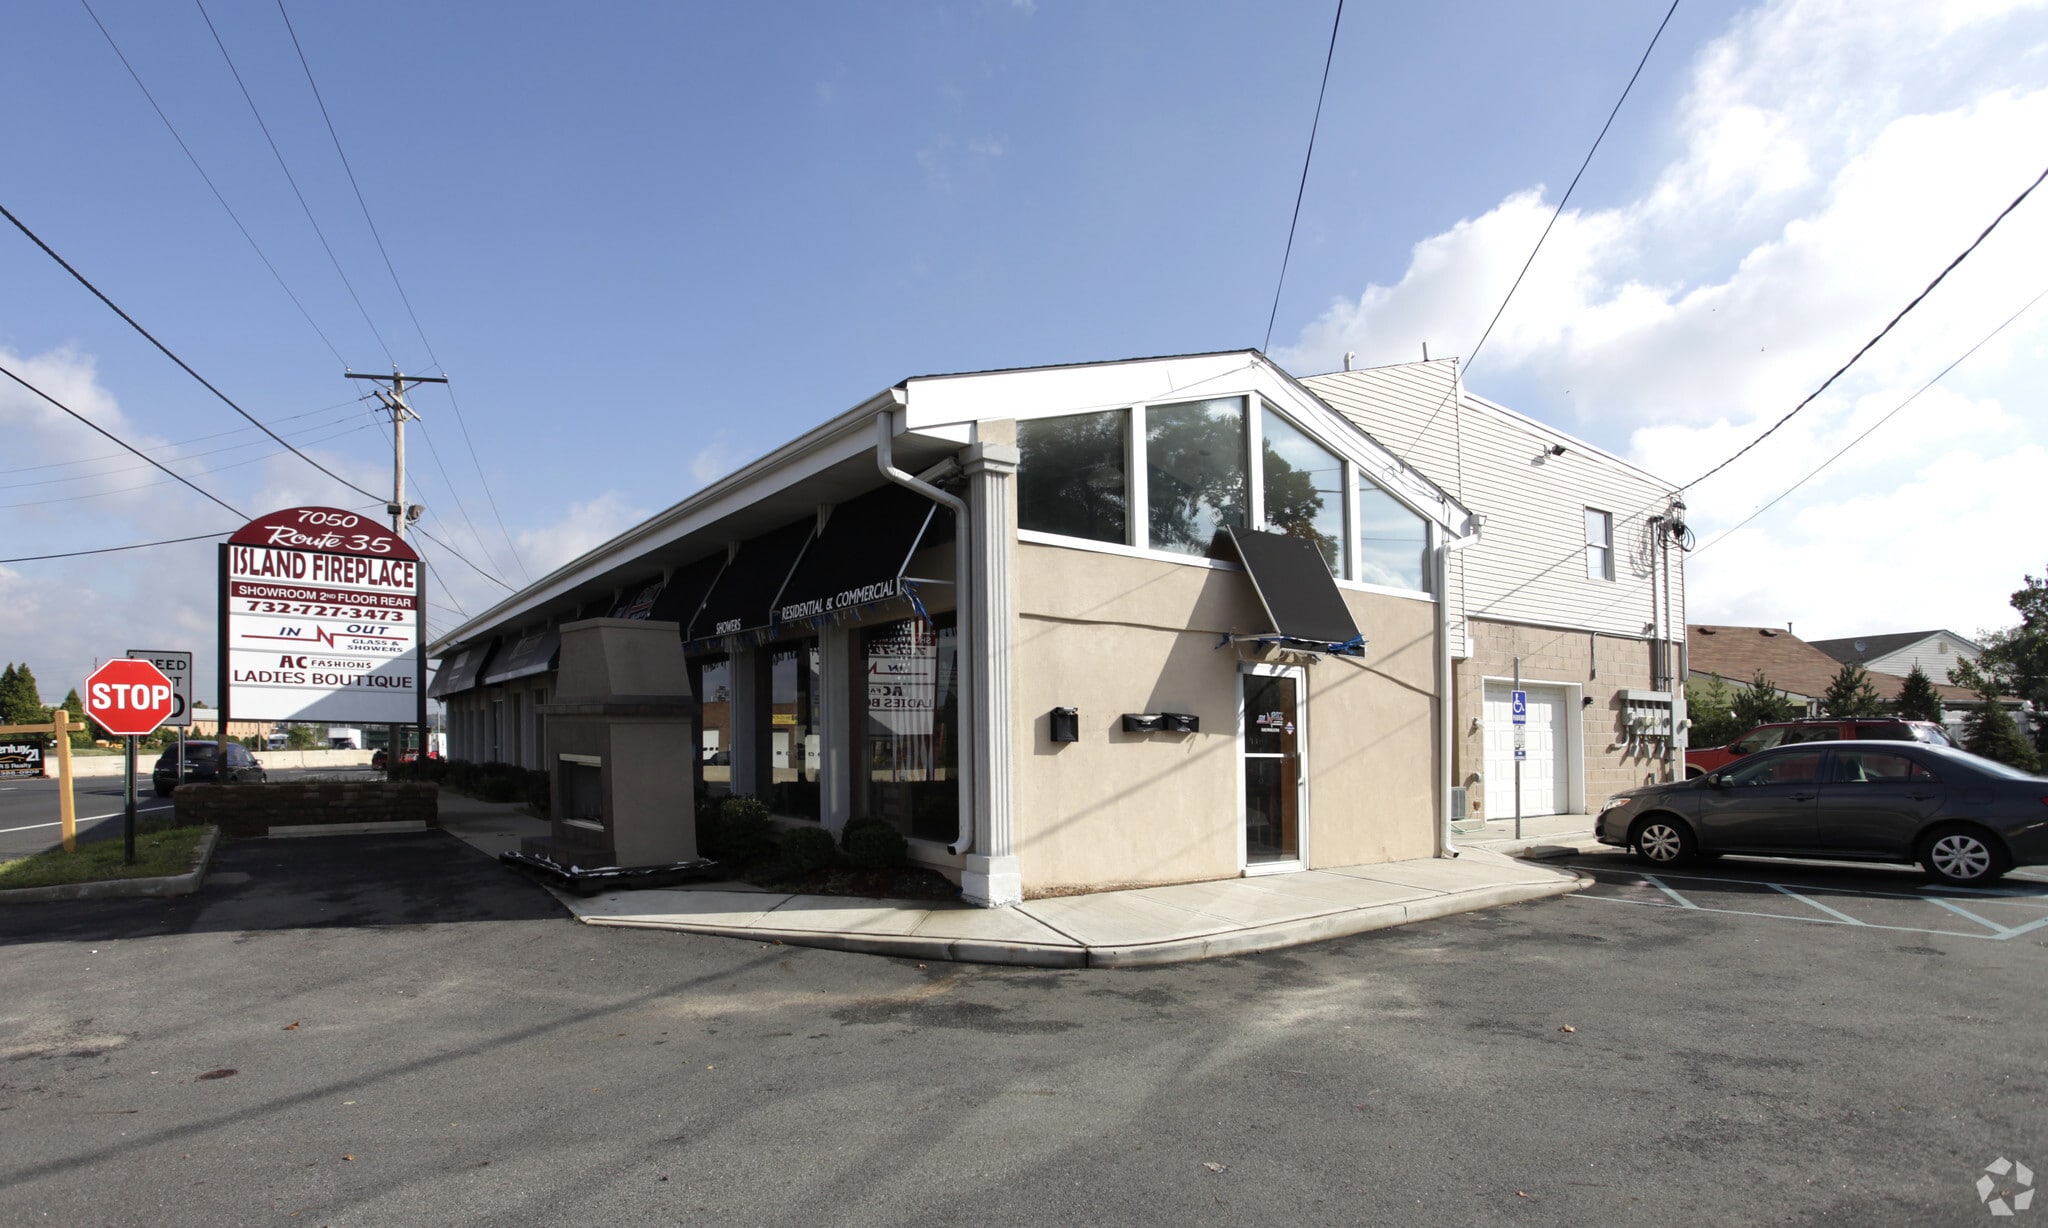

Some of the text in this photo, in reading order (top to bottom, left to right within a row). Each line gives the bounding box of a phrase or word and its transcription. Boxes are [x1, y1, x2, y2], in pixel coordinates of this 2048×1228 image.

[297, 510, 359, 528] 7050
[264, 525, 393, 553] Route 35
[233, 546, 414, 588] ISLAND FIREPLACE
[238, 585, 317, 601] SHOWROOM
[337, 593, 378, 605] FLOOR
[380, 596, 412, 608] REAR
[781, 579, 895, 621] RESIDENTIAL & COMMERCIAL
[246, 600, 404, 622] 732-727-3473
[279, 626, 302, 637] IN
[346, 624, 390, 635] OUT
[715, 618, 742, 635] SHOWERS
[347, 645, 403, 653] SHOWERS
[148, 659, 187, 671] EED
[279, 655, 372, 669] AC FASHIONS
[234, 670, 413, 689] LADIES BOUTIQUE
[92, 682, 170, 711] STOP
[0, 744, 41, 761] entury 21
